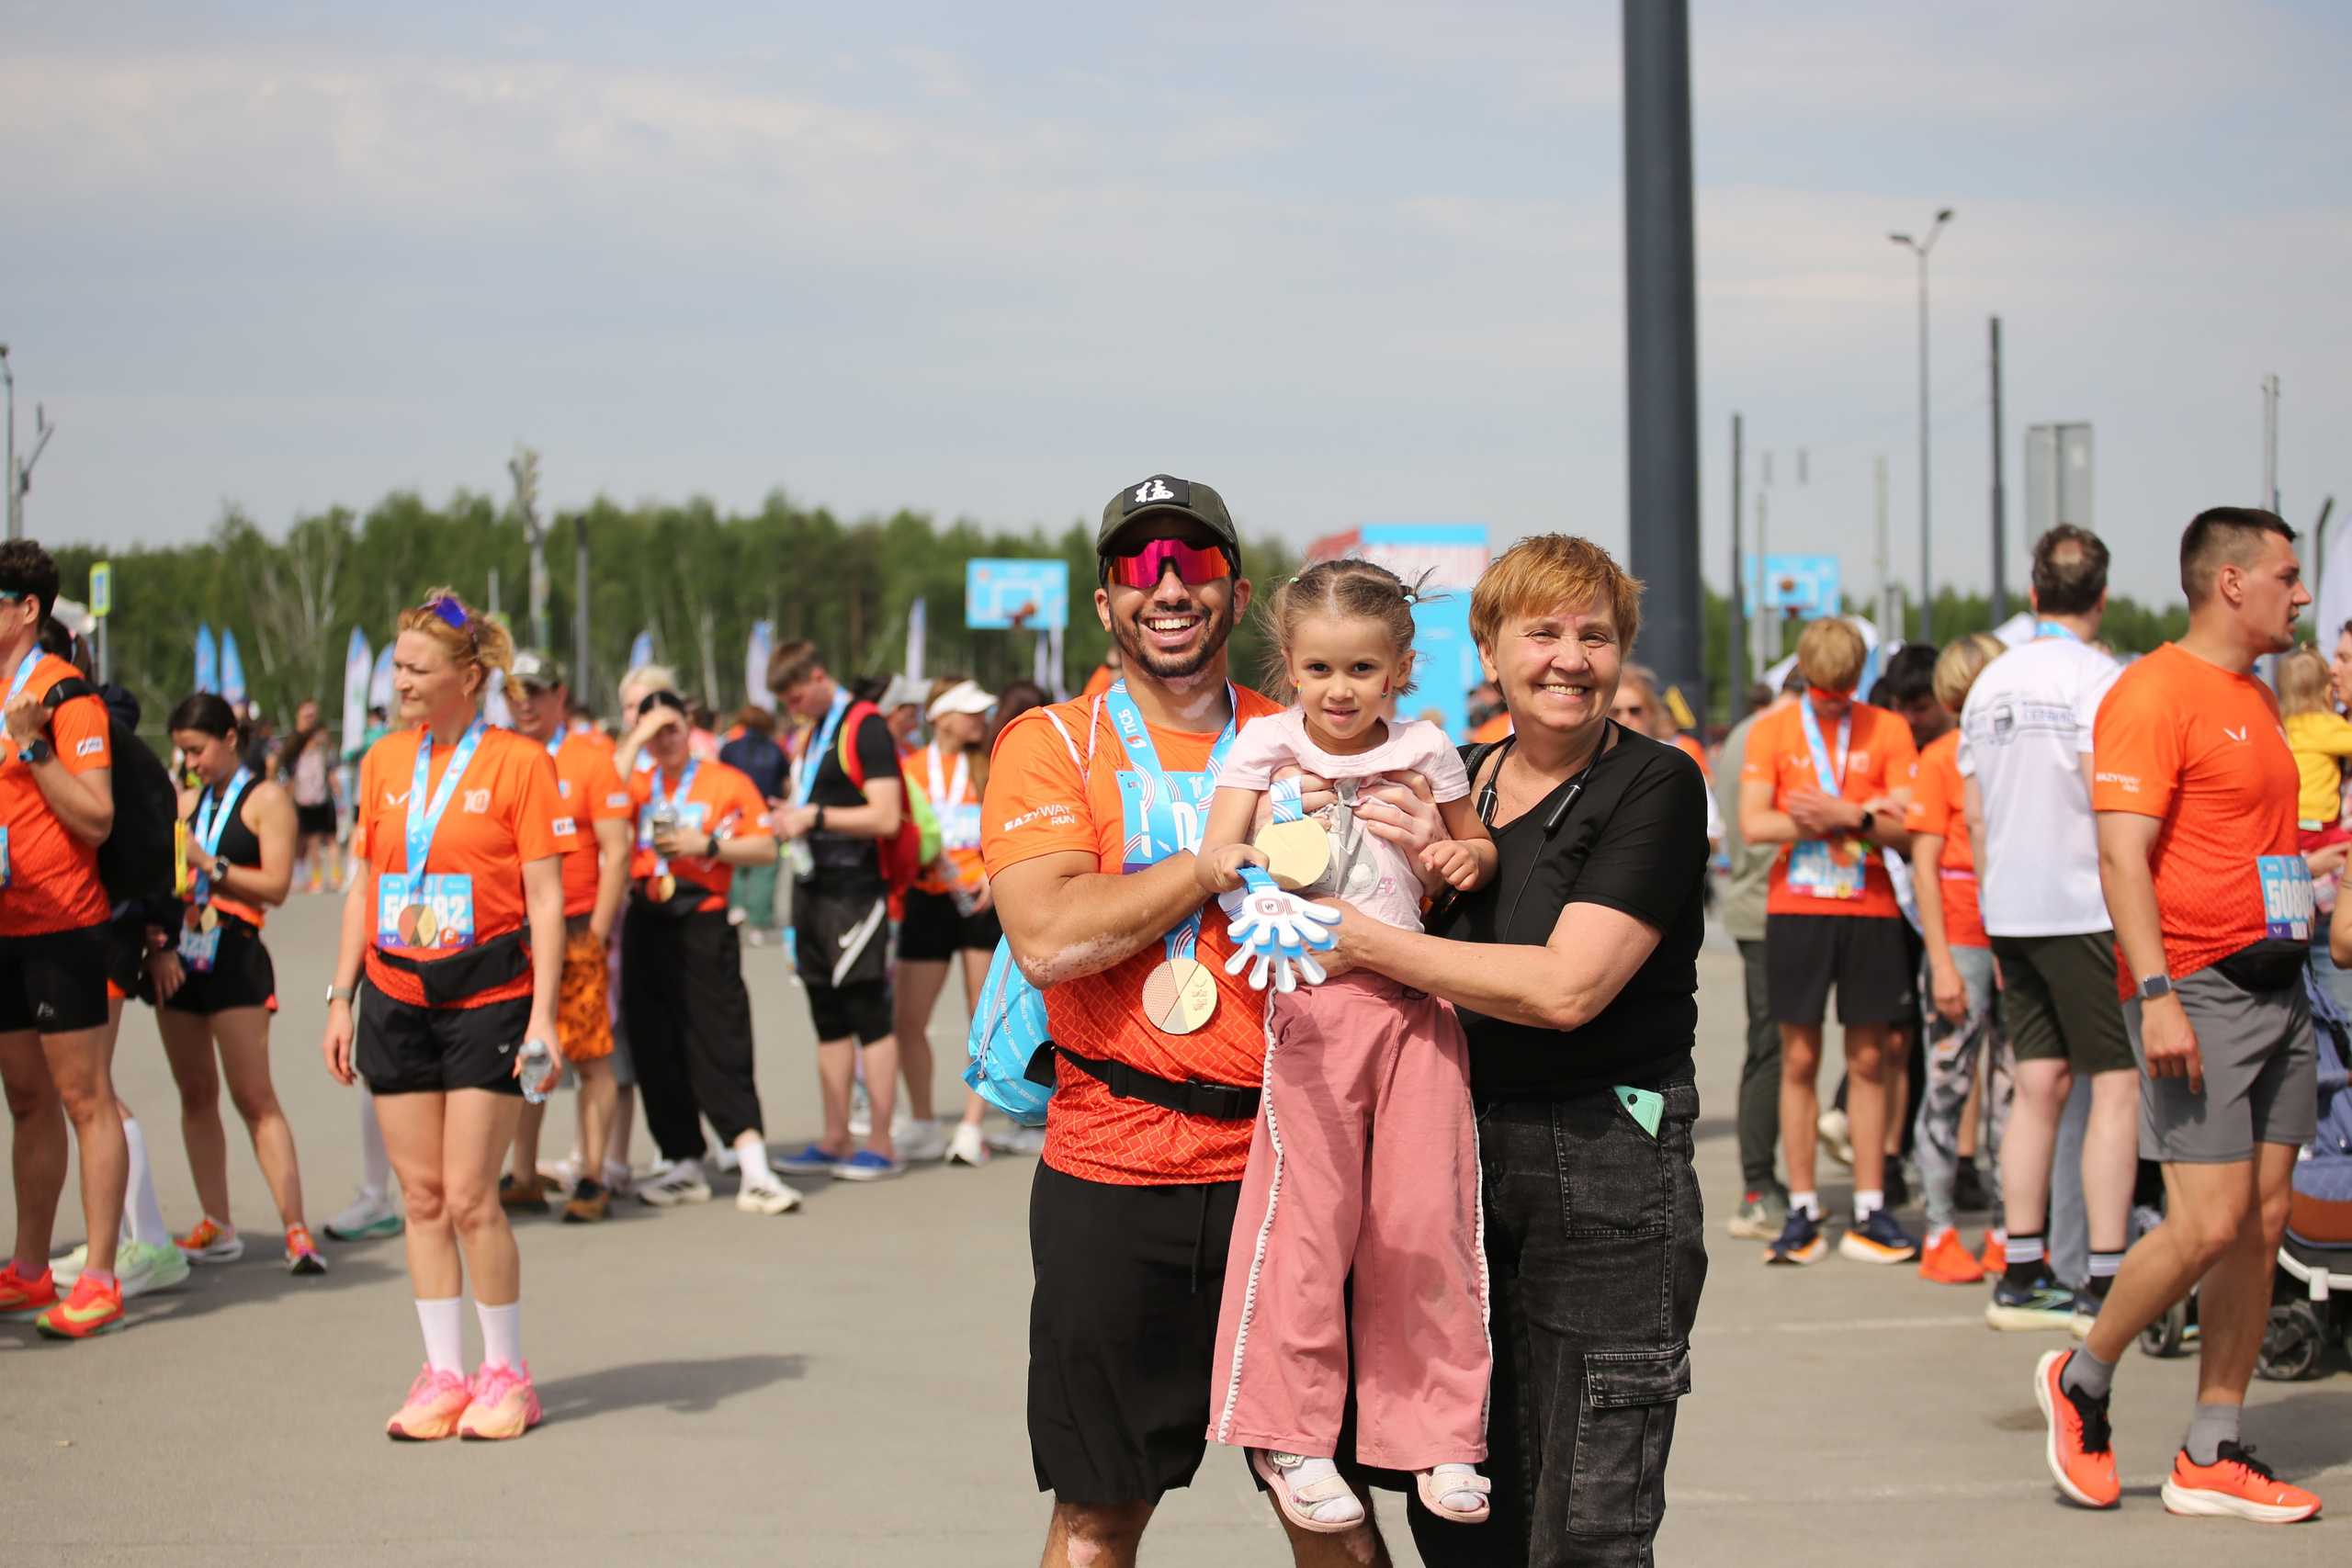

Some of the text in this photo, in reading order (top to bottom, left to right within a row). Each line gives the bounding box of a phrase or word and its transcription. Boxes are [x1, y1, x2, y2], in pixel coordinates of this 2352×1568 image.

[1117, 708, 1138, 734] ПСБ
[463, 789, 492, 814] 10
[1004, 805, 1069, 832] EAZYWAY
[1051, 815, 1075, 826] RUN
[384, 895, 467, 931] 582
[444, 928, 455, 942] F
